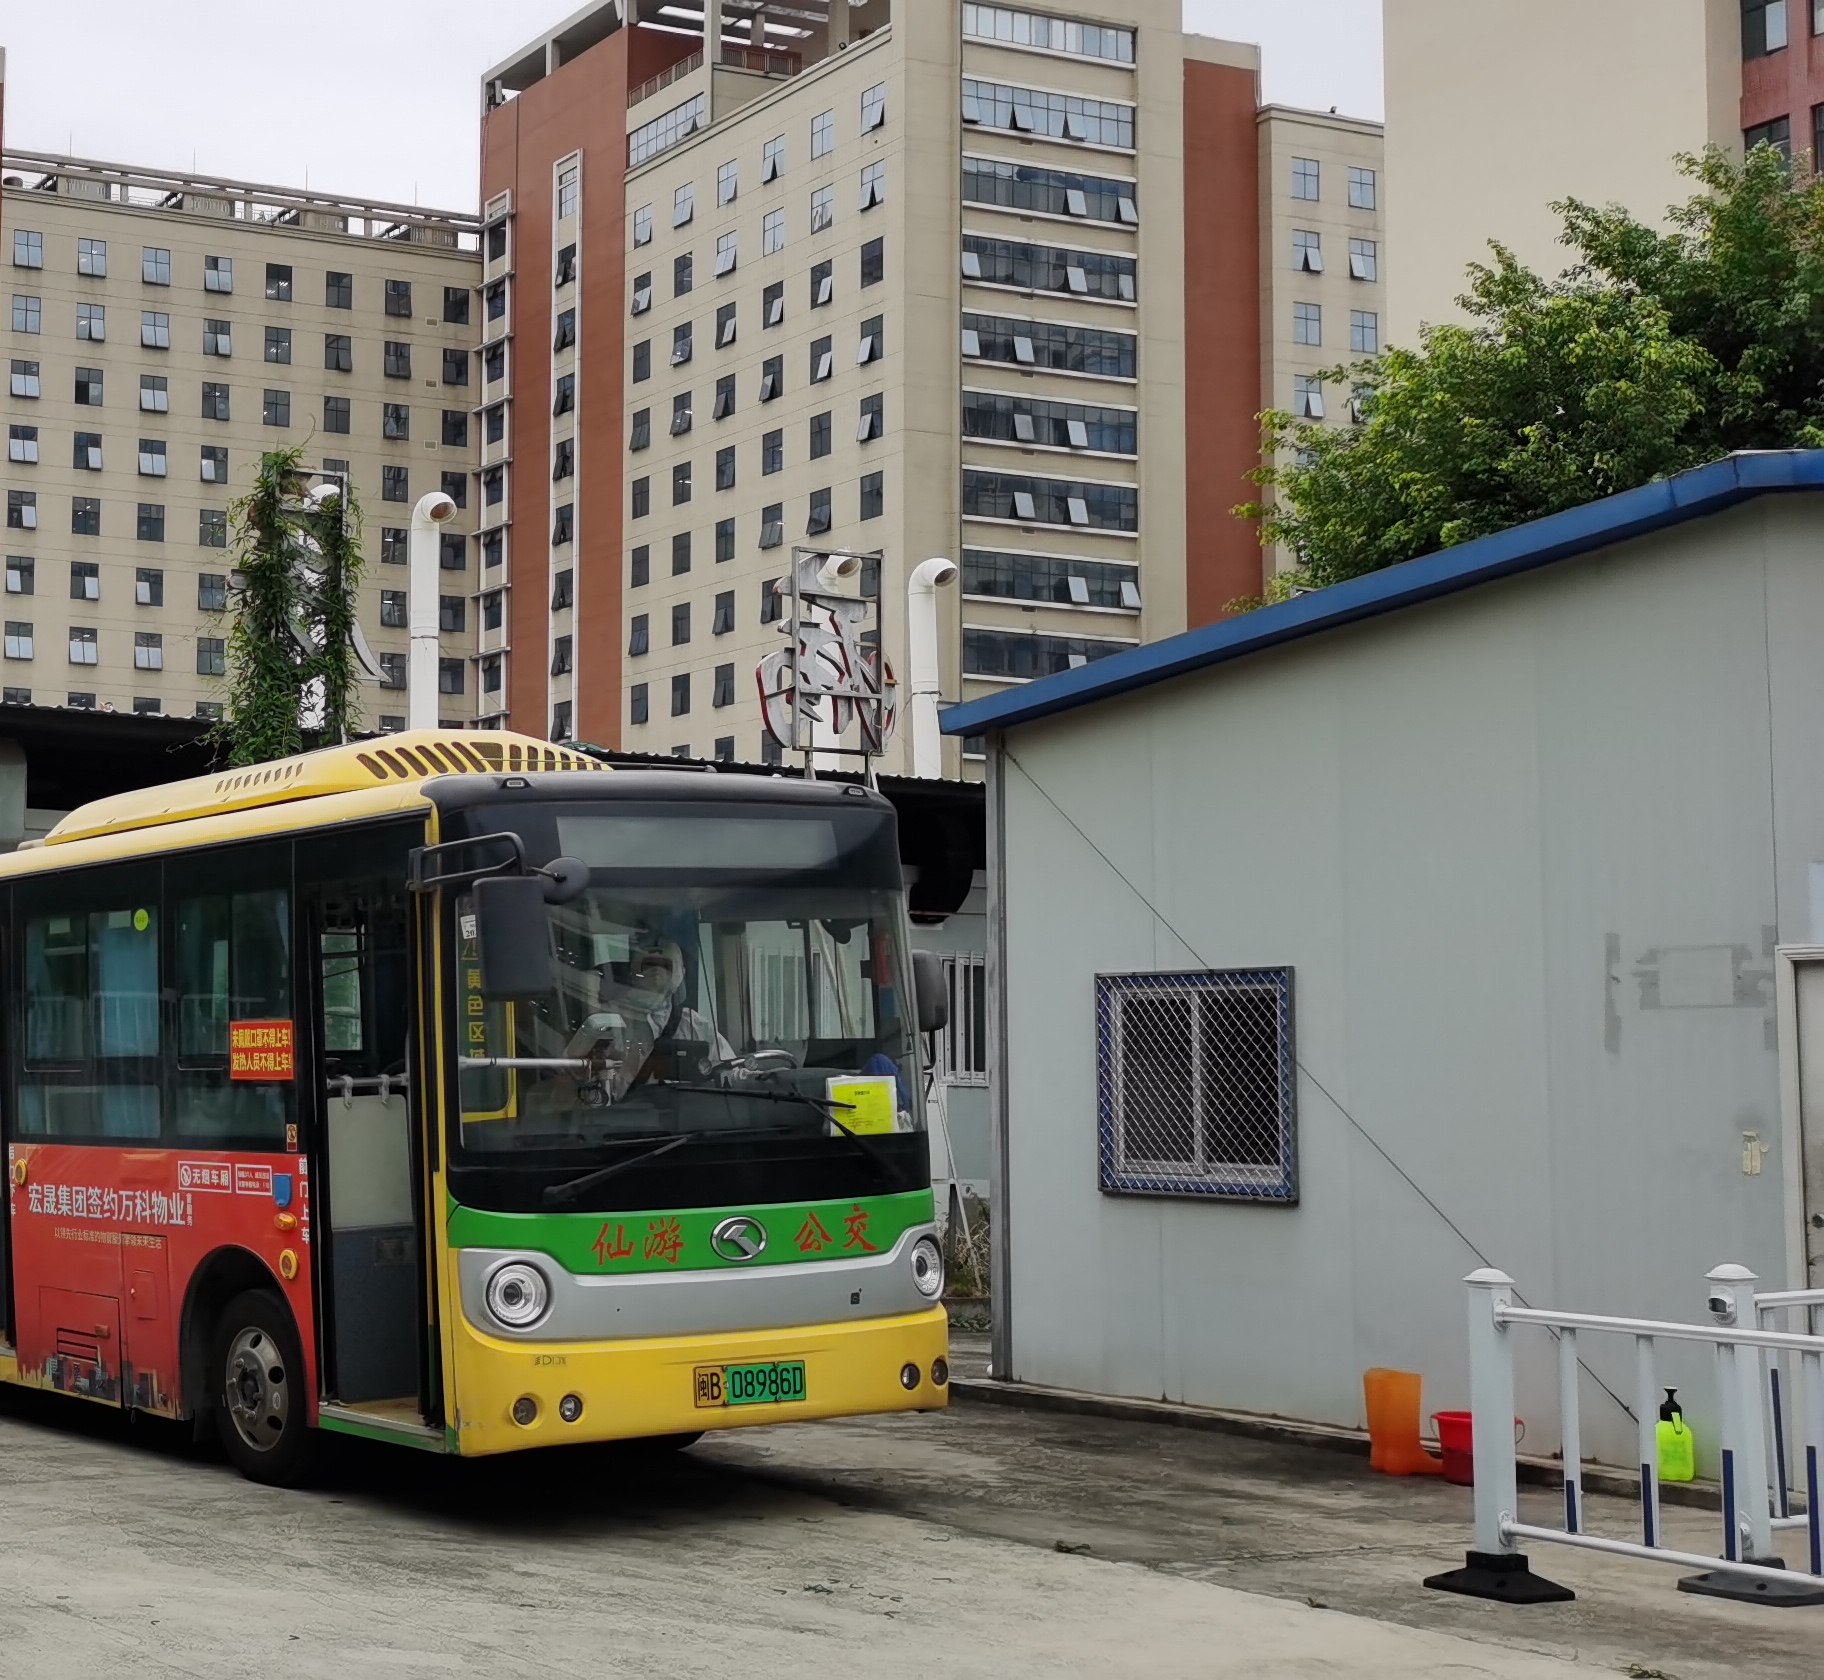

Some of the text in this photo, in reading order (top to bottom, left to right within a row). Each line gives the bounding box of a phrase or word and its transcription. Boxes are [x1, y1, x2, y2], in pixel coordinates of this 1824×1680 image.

[192, 1168, 229, 1187] 无烟车厢
[28, 1182, 186, 1227] 宏晟集团签约万科物业
[298, 1157, 309, 1244] 前门上车
[591, 1203, 878, 1266] 仙游 公交
[731, 1366, 804, 1398] 08986D
